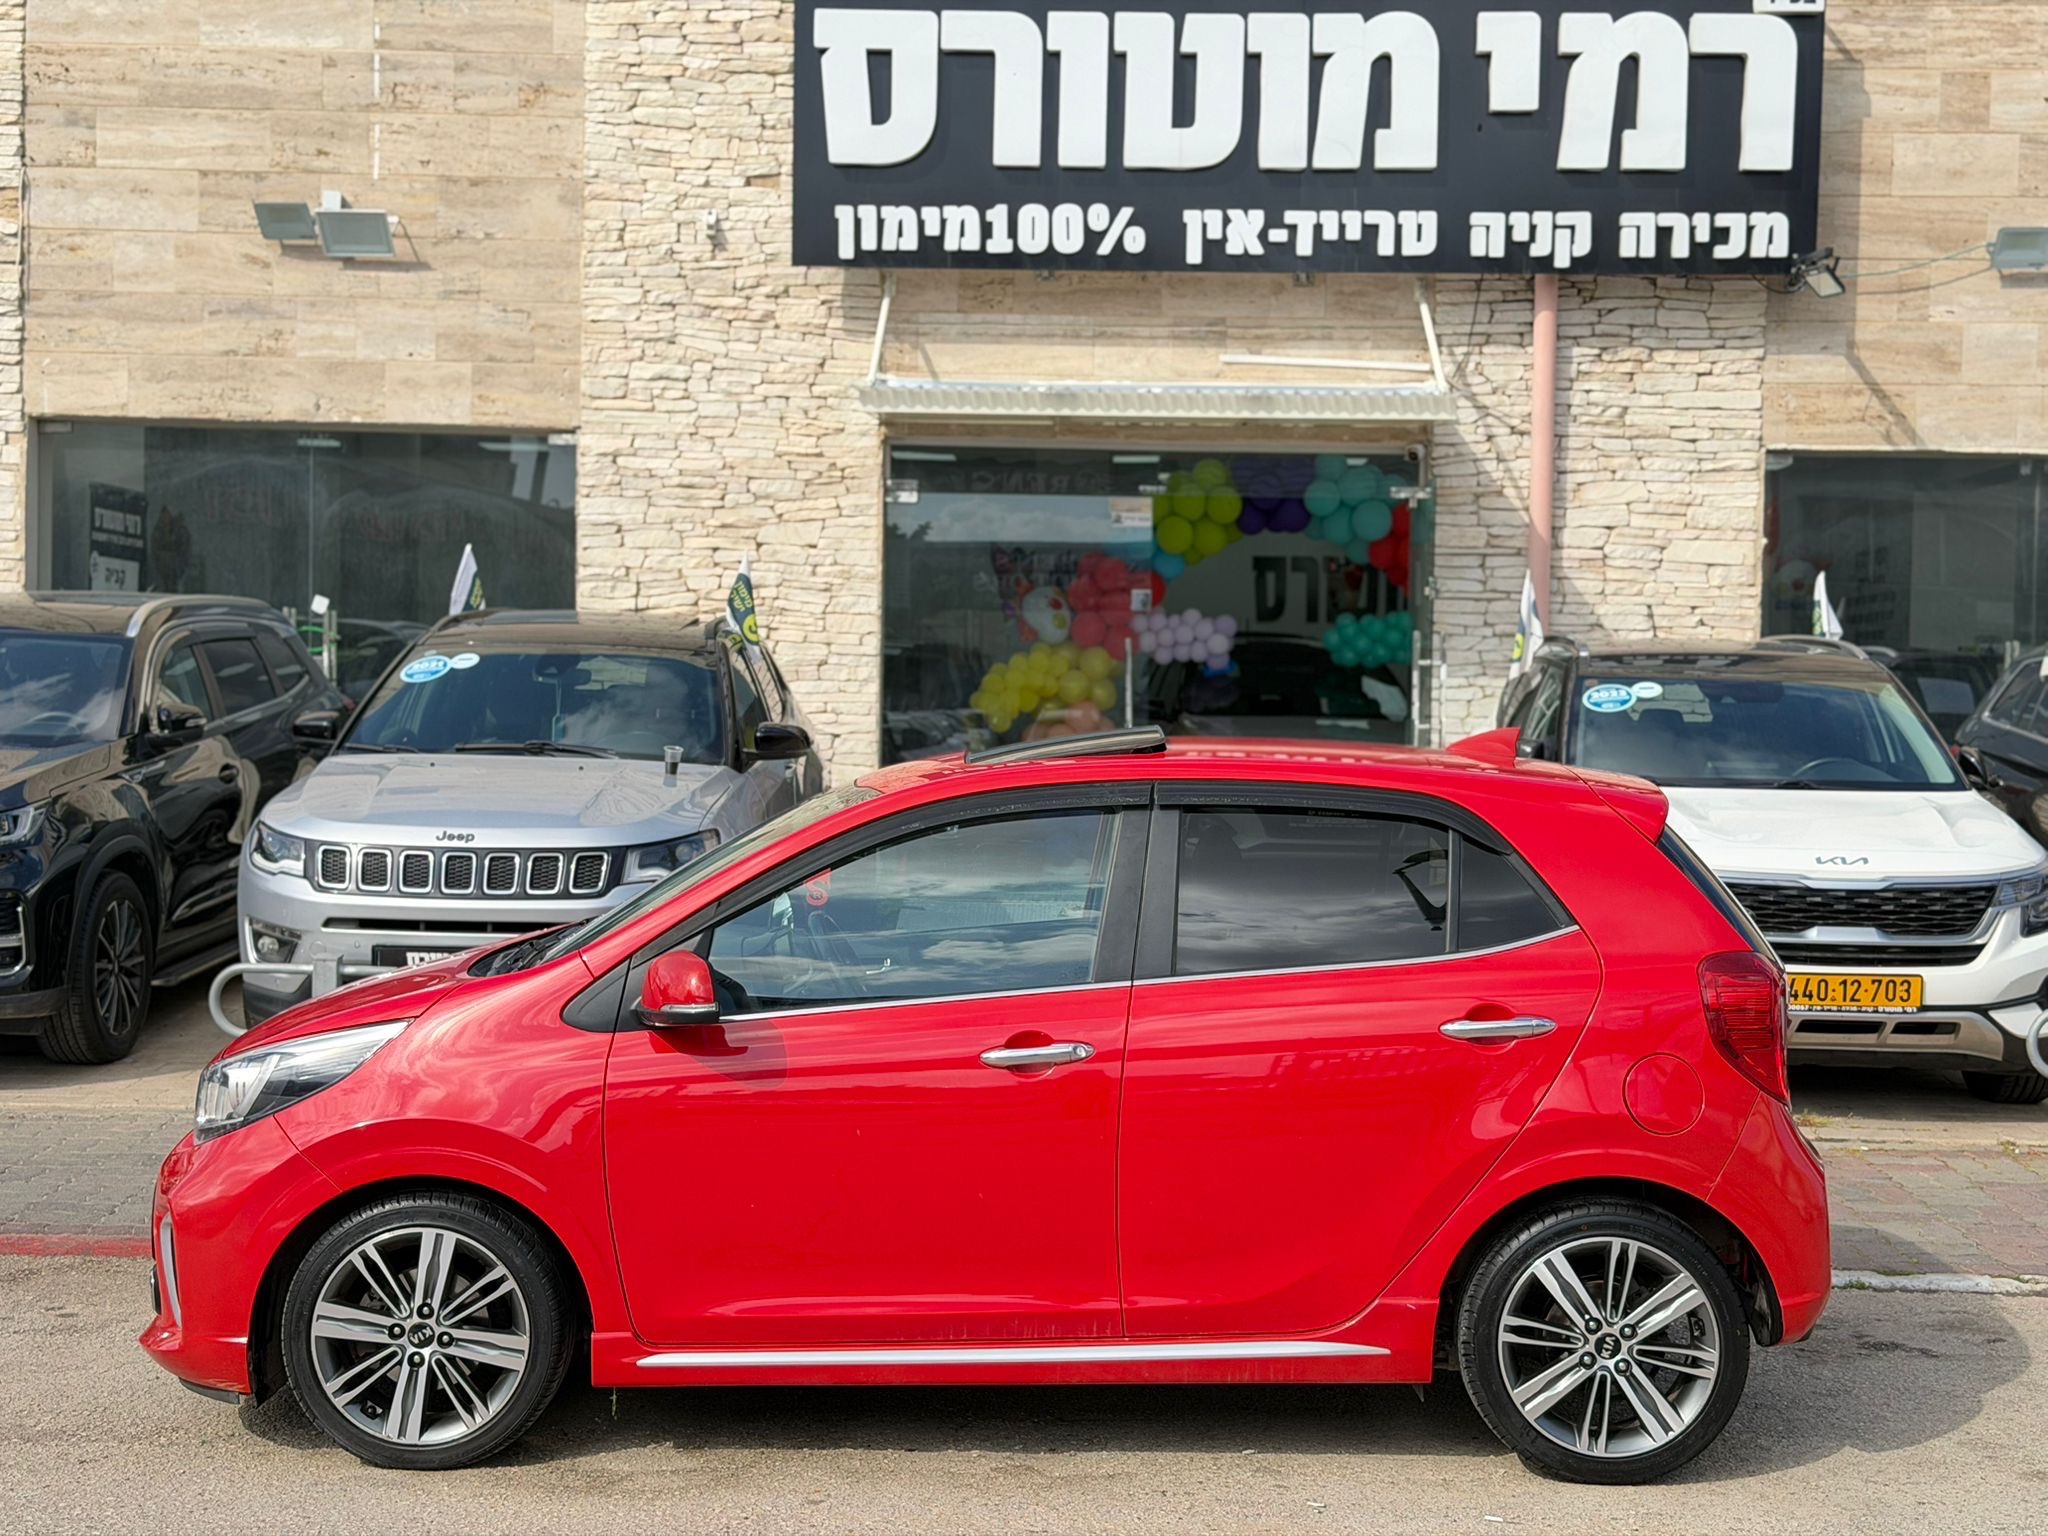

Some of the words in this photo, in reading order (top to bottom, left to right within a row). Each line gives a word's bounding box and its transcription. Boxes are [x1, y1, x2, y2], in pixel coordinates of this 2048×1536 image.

[813, 8, 1440, 170] מוטורס
[1476, 10, 1798, 171] רמי
[1182, 208, 1438, 265] טרייד-אין
[1469, 210, 1593, 269] קניה
[1618, 211, 1790, 259] מכירה
[435, 830, 475, 844] Jeep
[409, 1326, 433, 1344] KIA
[1600, 1336, 1616, 1359] KIA
